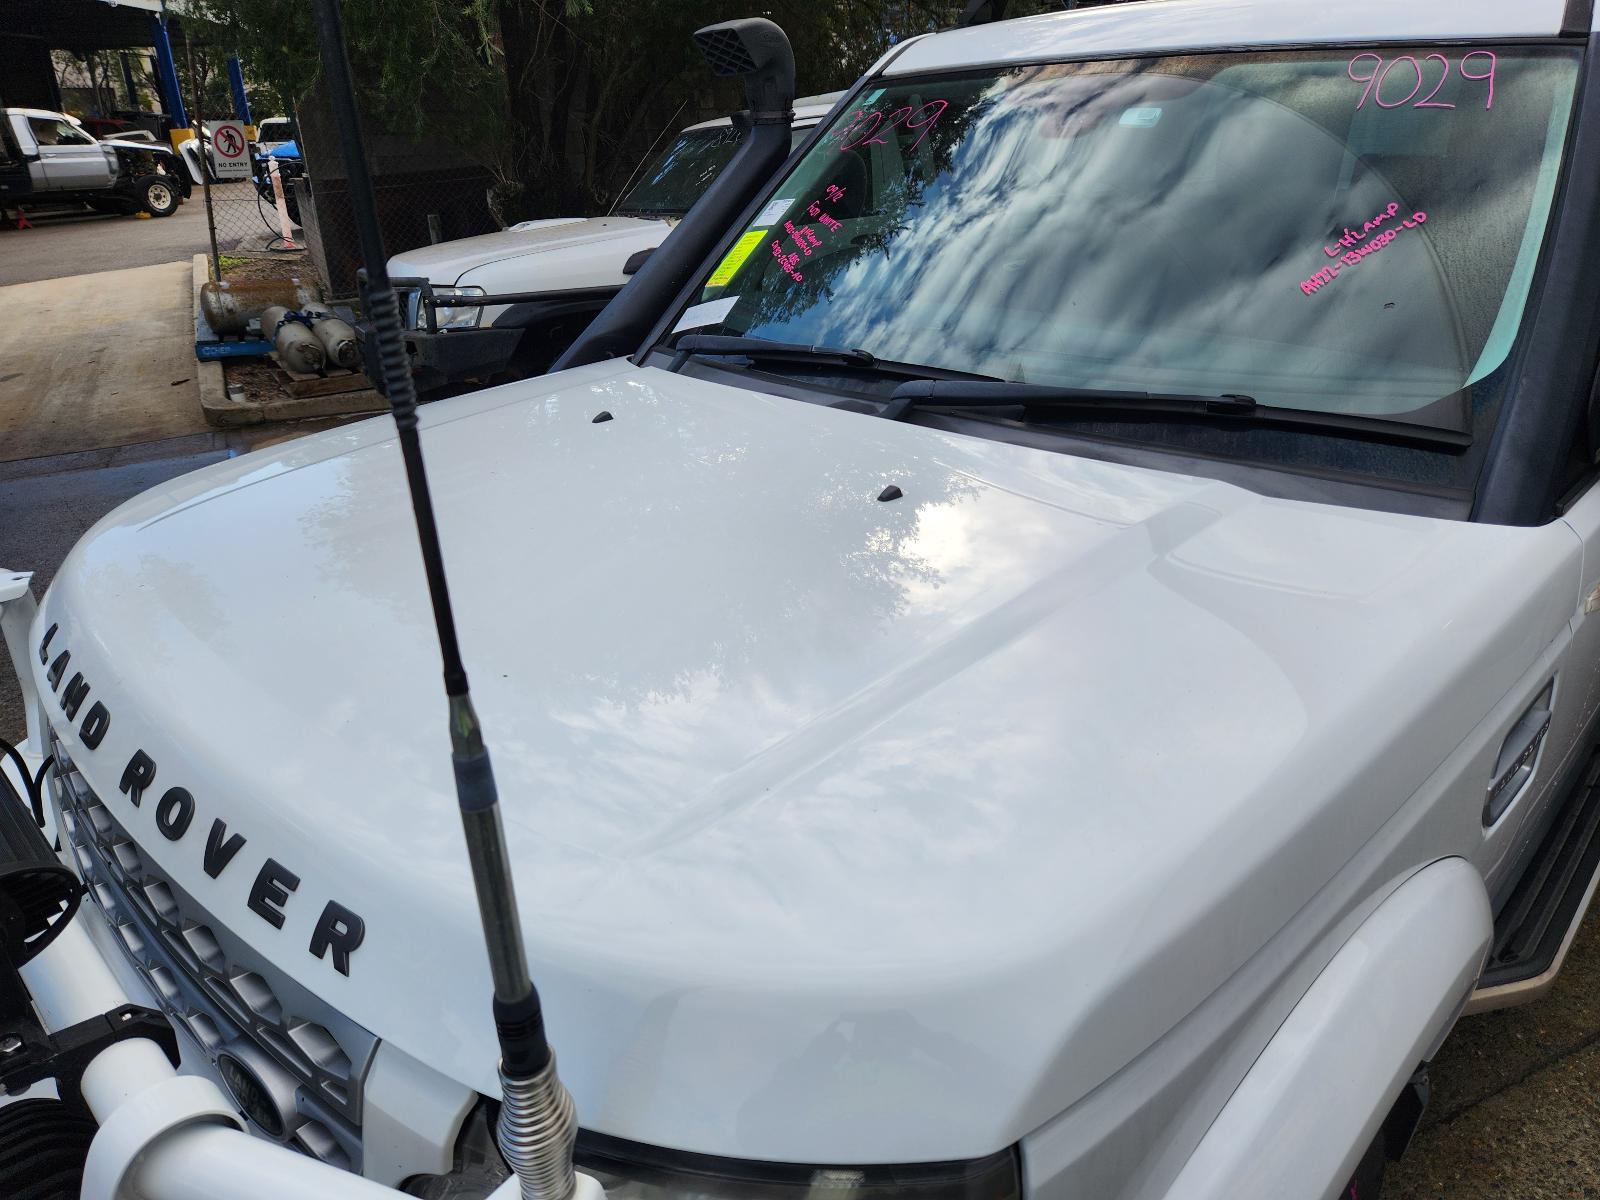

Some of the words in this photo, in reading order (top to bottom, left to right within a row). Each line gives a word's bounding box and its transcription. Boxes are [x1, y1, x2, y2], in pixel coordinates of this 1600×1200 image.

[1347, 51, 1496, 110] 9029
[39, 622, 111, 751] LAND
[118, 748, 366, 978] ROVER
